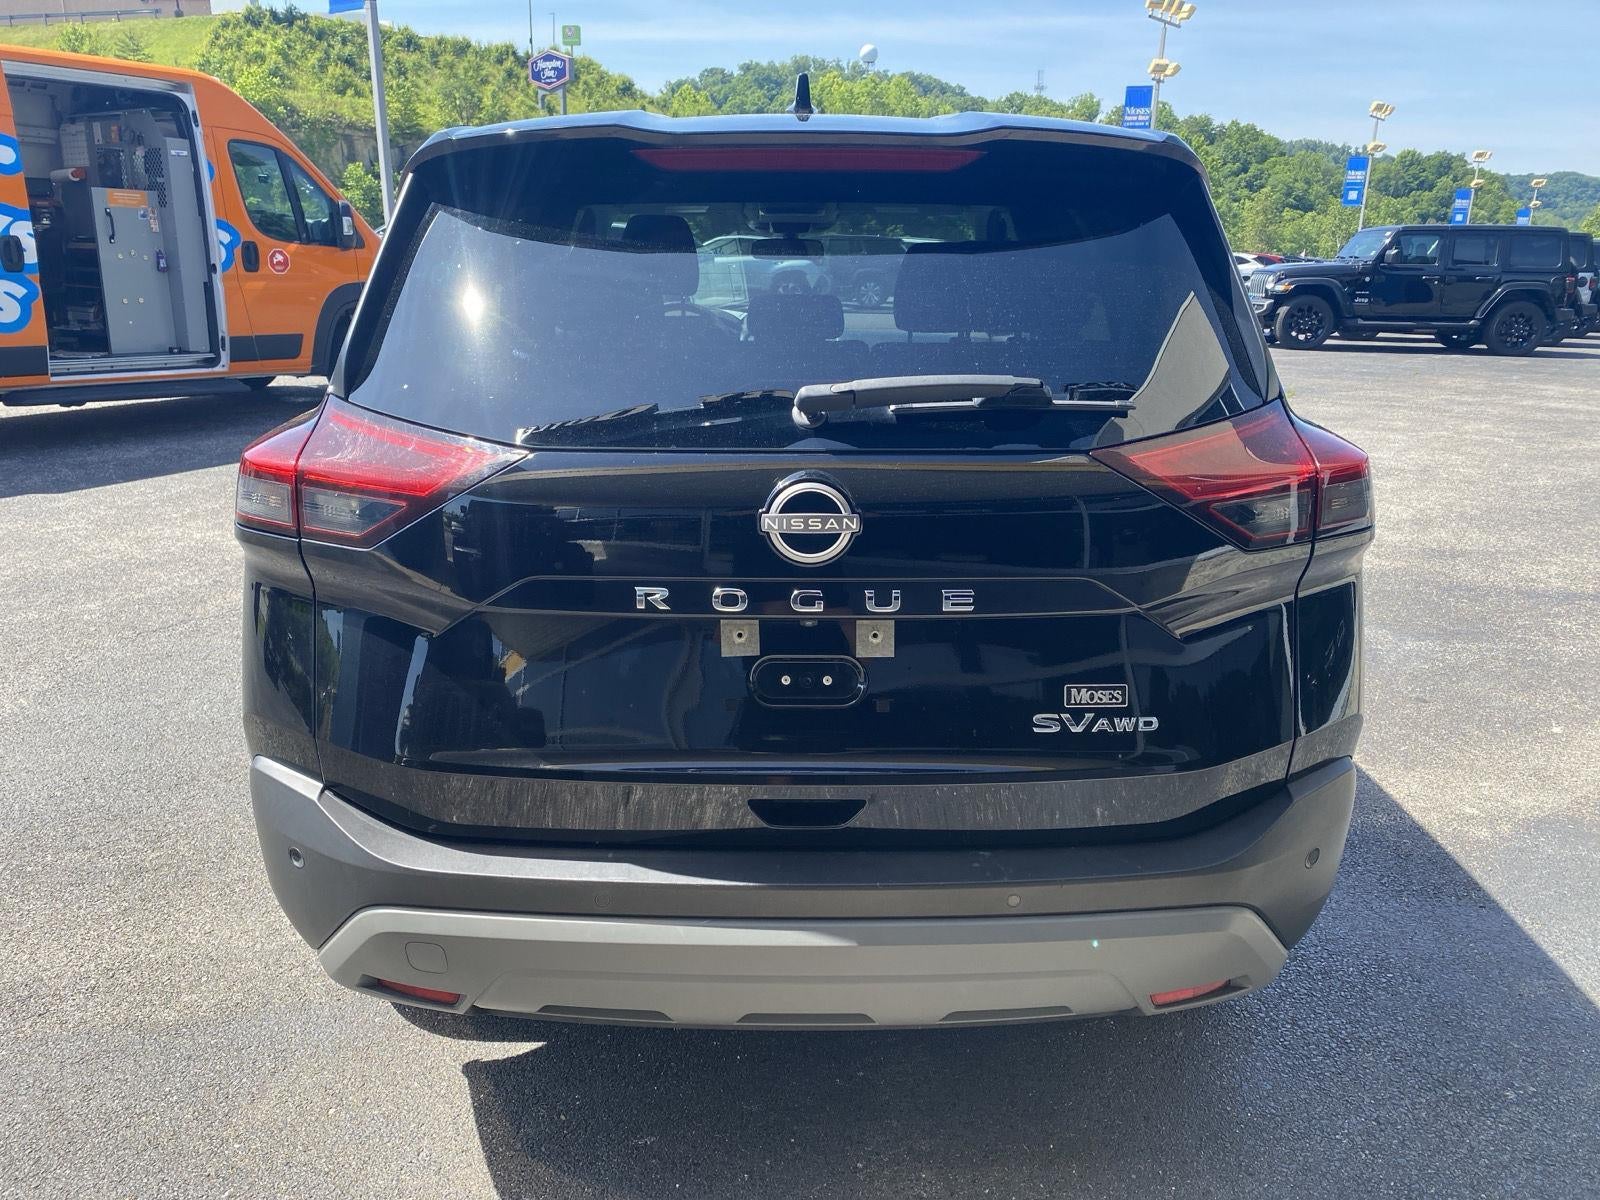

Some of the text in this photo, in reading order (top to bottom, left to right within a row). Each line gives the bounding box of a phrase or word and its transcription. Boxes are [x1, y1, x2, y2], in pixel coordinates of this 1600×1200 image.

[533, 59, 564, 71] Hampton
[764, 518, 858, 531] NISSAN
[634, 586, 976, 612] ROGUE
[1069, 688, 1123, 704] MOSES
